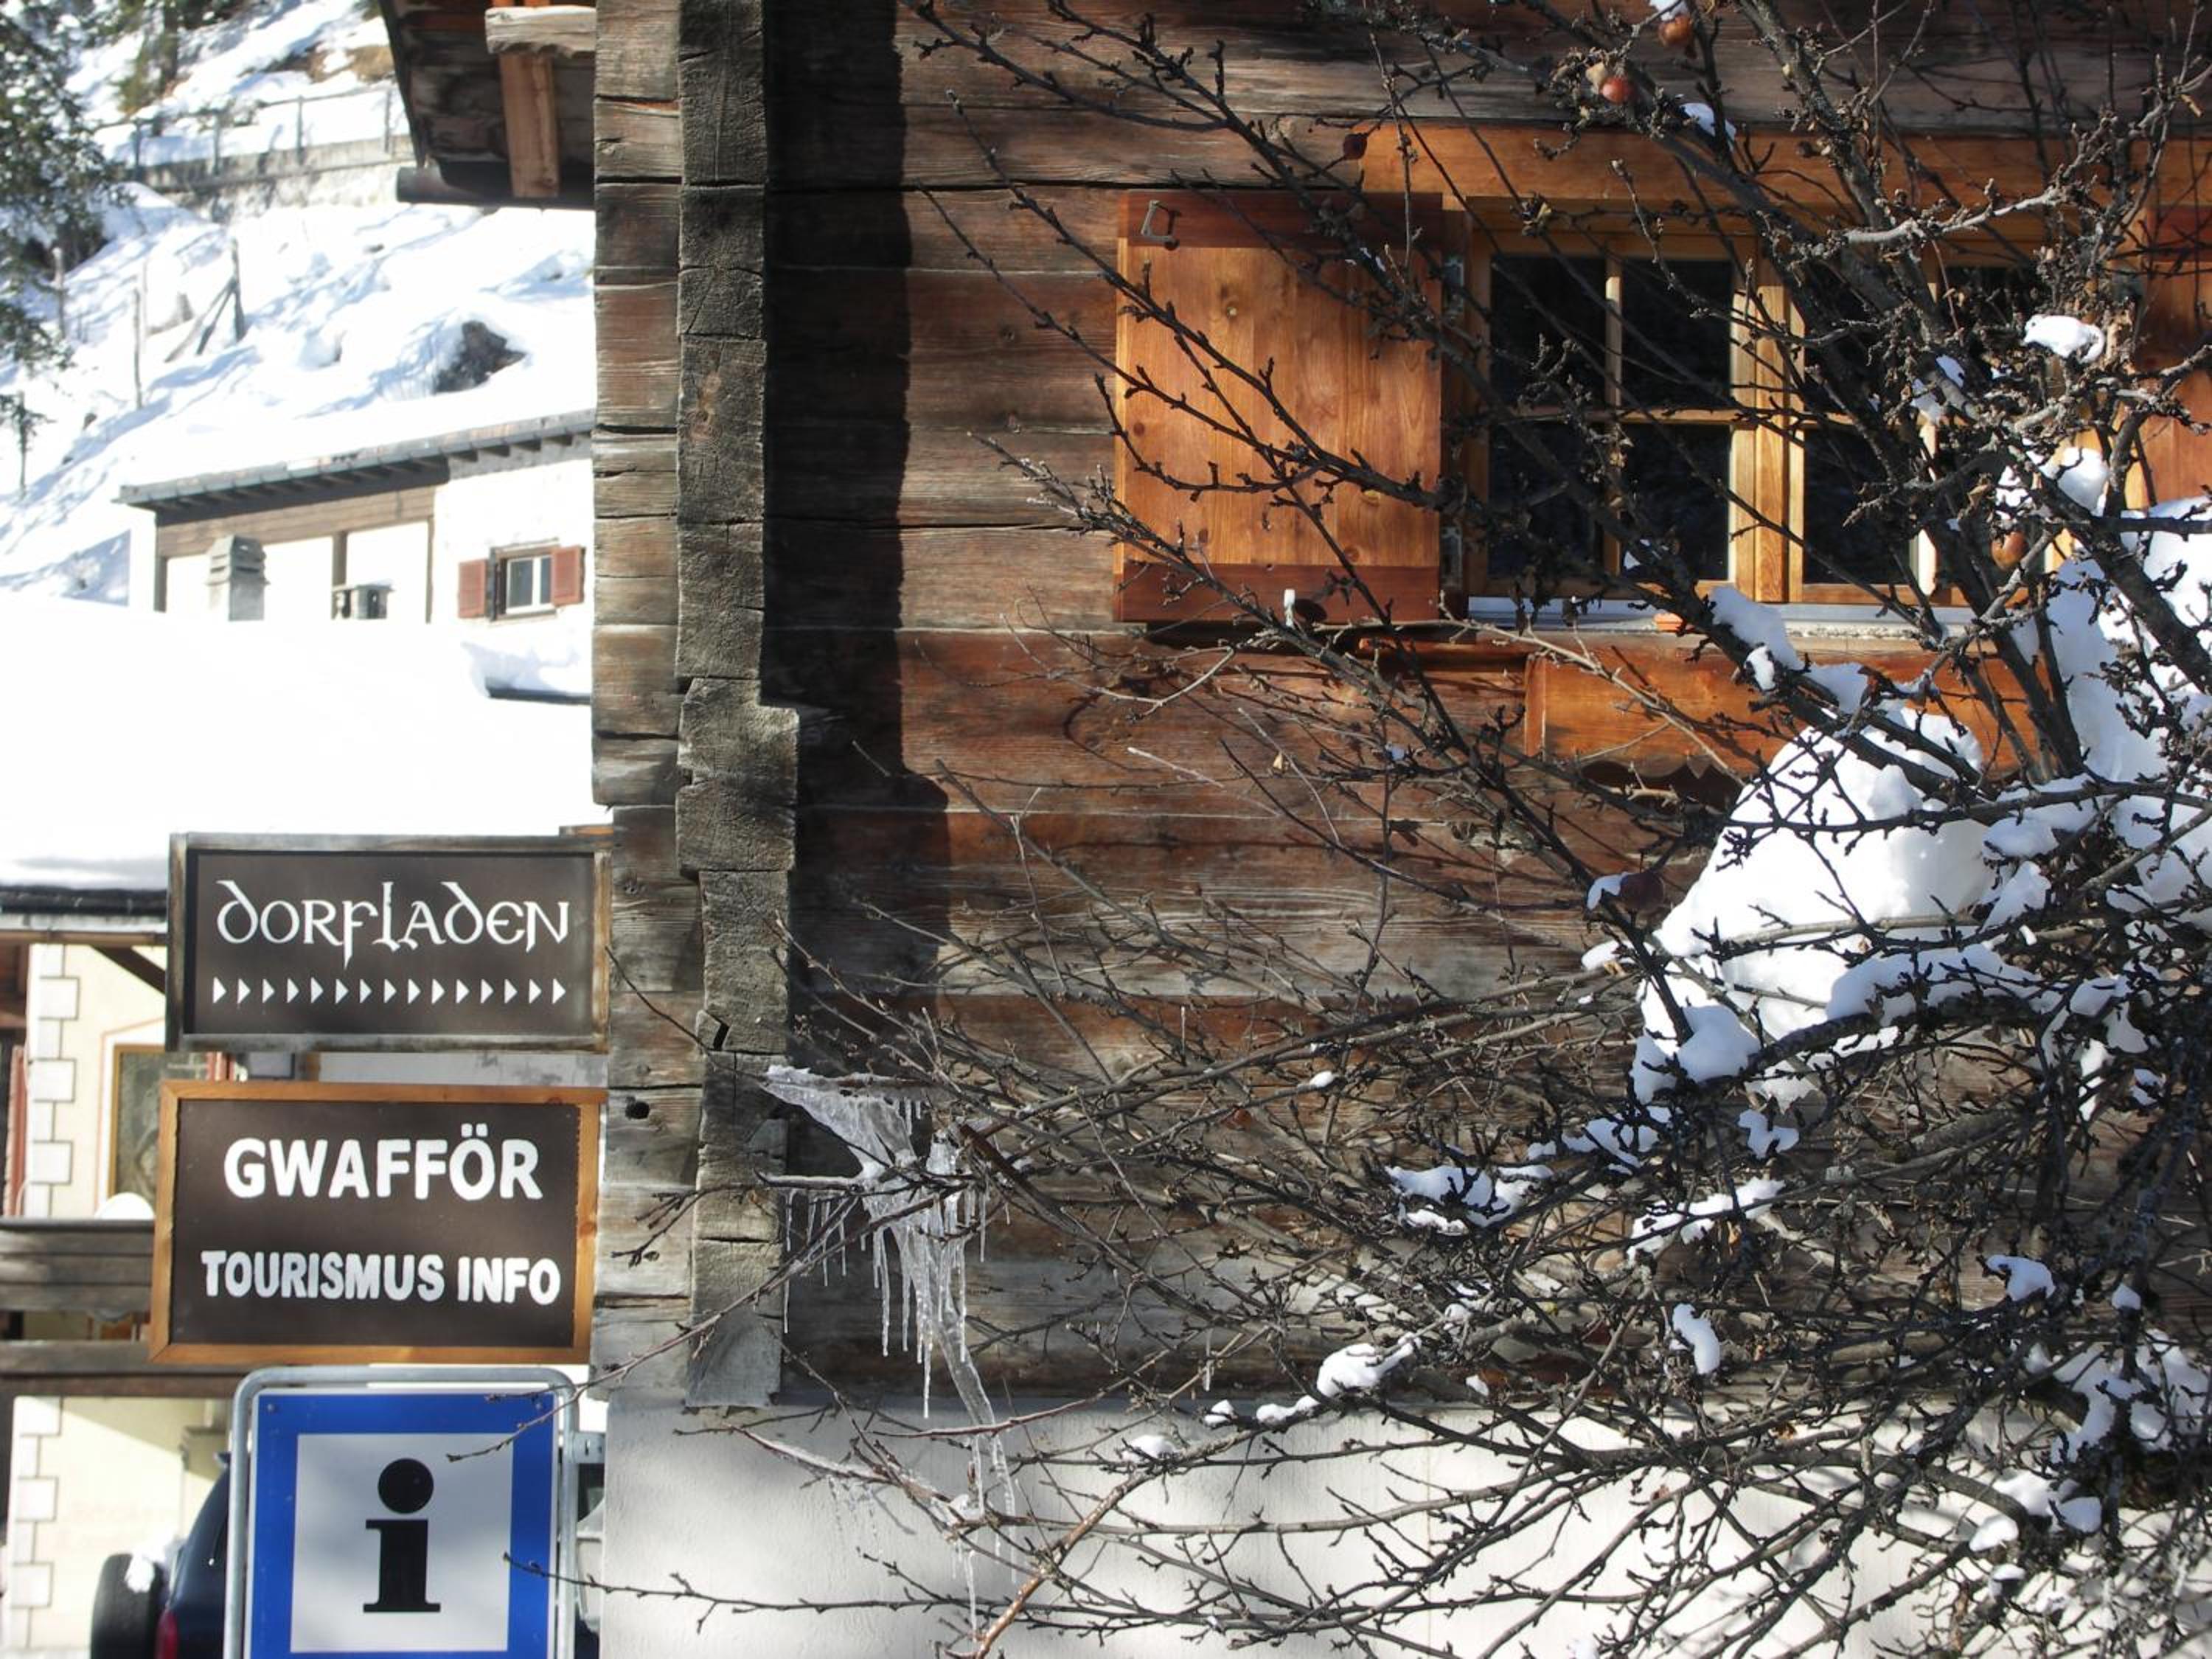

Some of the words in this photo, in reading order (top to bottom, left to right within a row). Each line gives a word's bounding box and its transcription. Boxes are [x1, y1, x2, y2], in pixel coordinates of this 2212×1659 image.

[223, 1124, 543, 1201] GWAFFÖR
[201, 1251, 445, 1301] TOURISMUS
[457, 1256, 560, 1305] INFO
